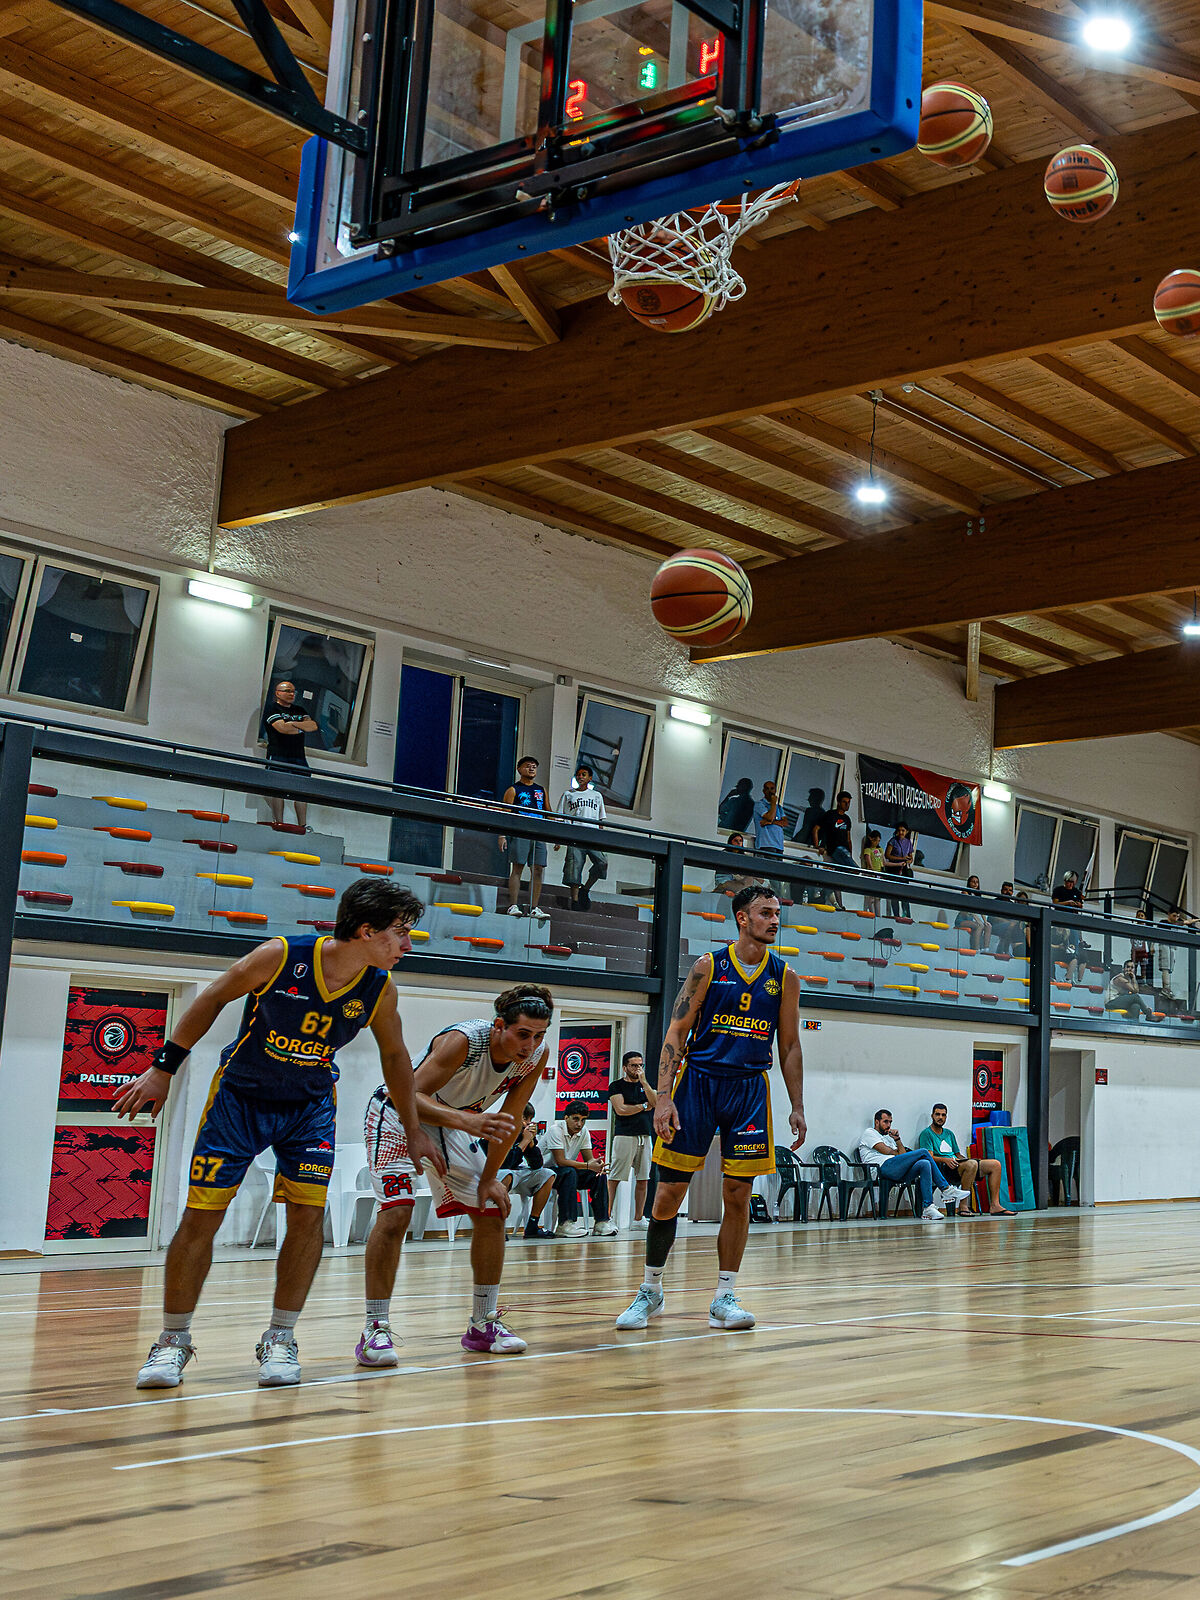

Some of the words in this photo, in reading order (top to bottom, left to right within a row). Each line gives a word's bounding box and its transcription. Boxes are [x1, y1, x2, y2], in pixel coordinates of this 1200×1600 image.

[861, 782, 905, 806] FIRMAMENTO
[905, 785, 942, 809] ROSSONERO
[739, 992, 752, 1012] 9
[300, 1011, 333, 1039] 67
[191, 1155, 224, 1183] 67
